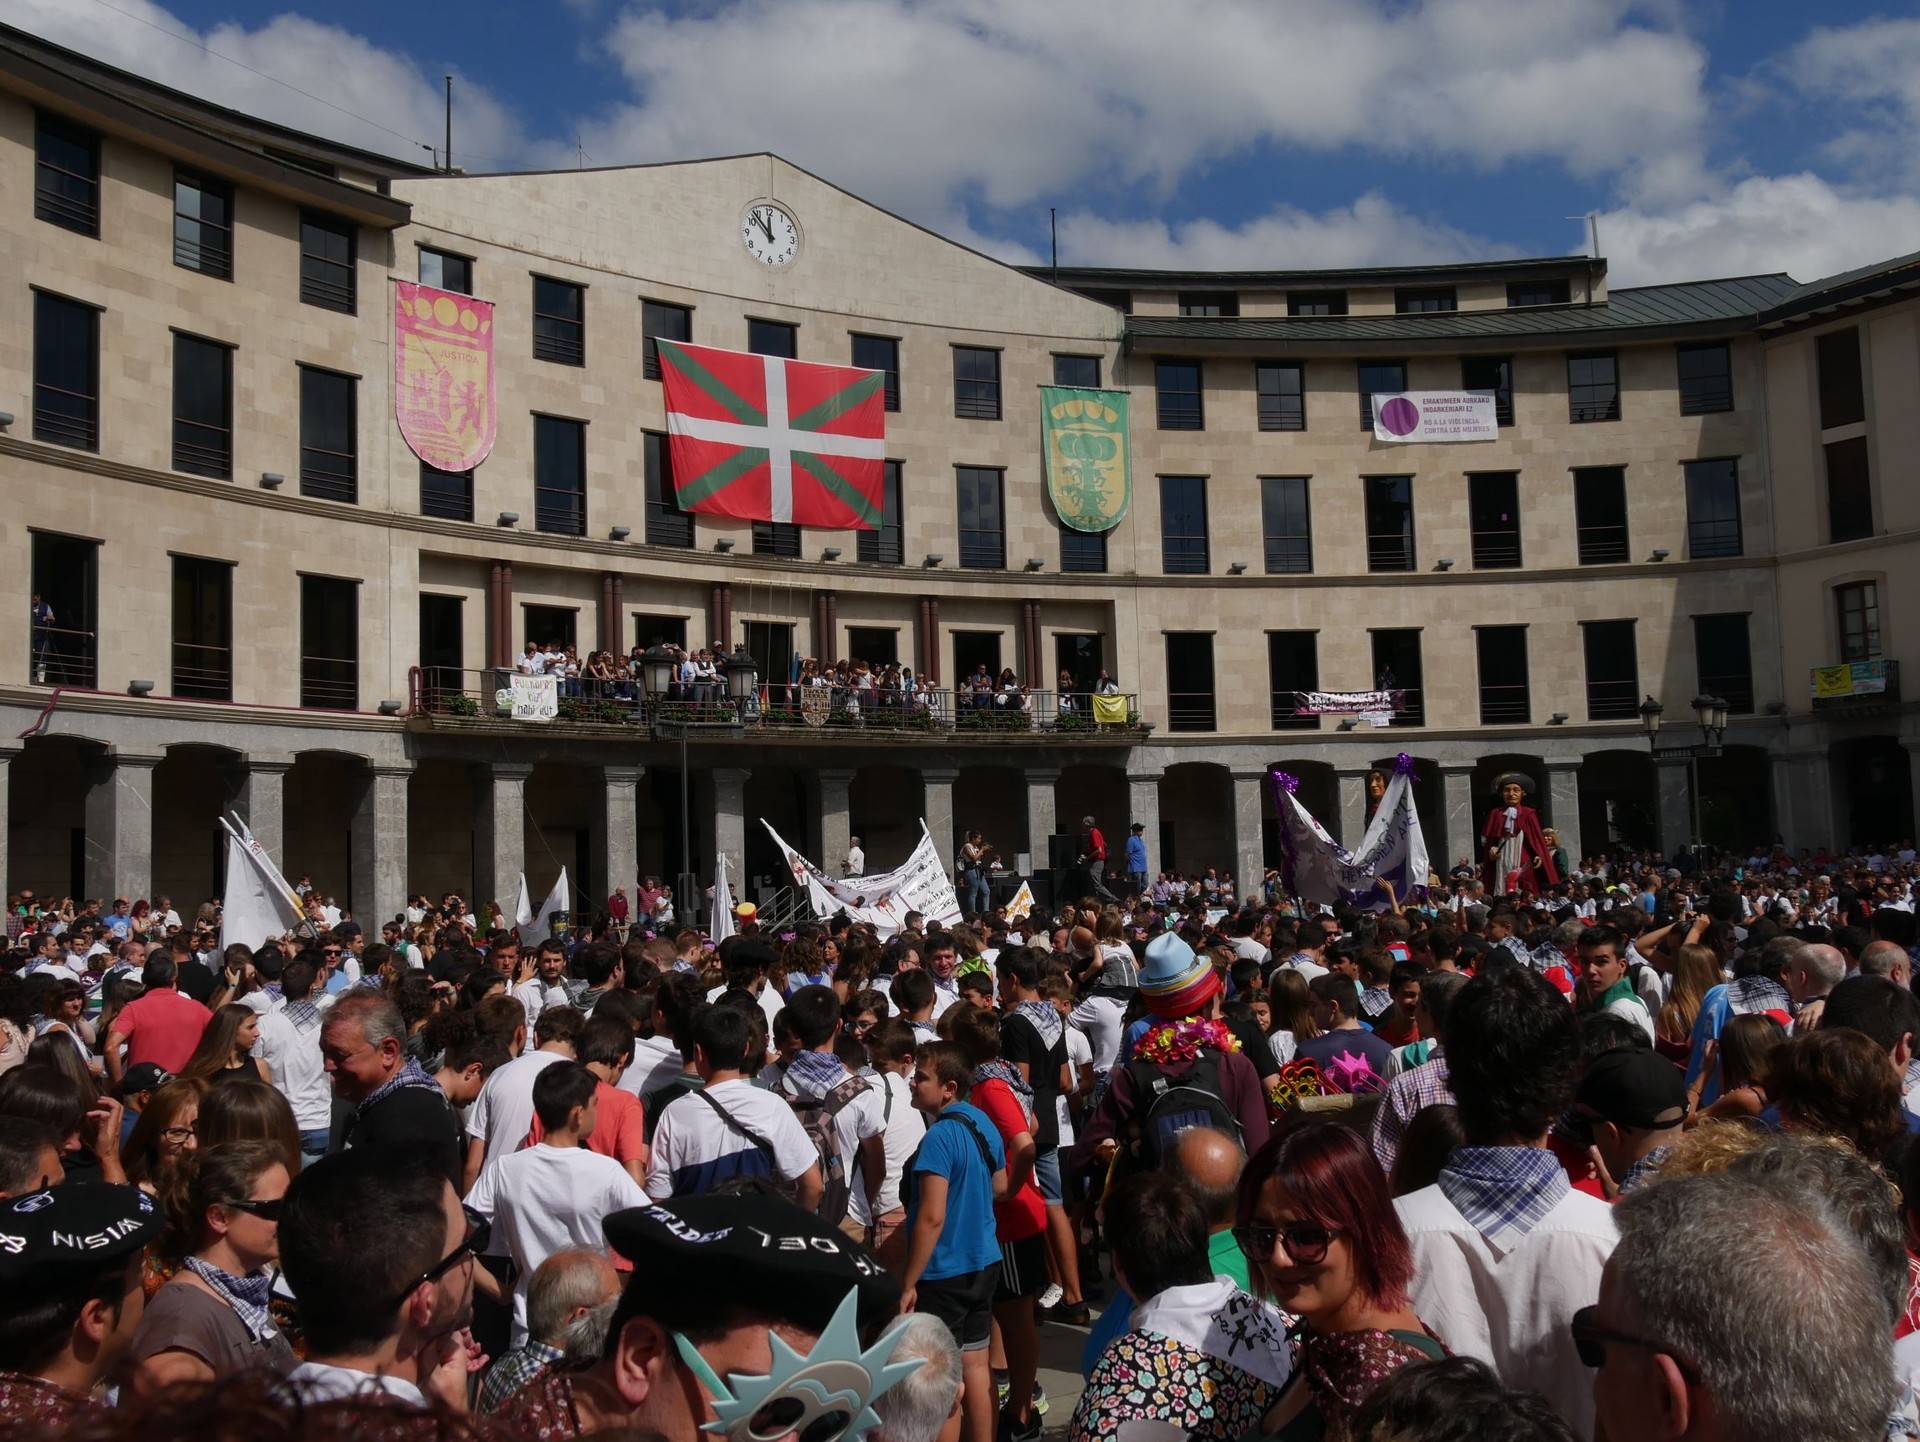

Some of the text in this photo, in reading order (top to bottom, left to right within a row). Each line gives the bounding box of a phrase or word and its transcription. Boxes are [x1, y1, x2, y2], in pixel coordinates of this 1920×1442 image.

[766, 208, 773, 217] 12
[748, 217, 756, 226] 10
[745, 228, 749, 237] 9
[787, 225, 792, 233] 2
[749, 240, 754, 248] 8
[52, 1217, 144, 1250] WISIN
